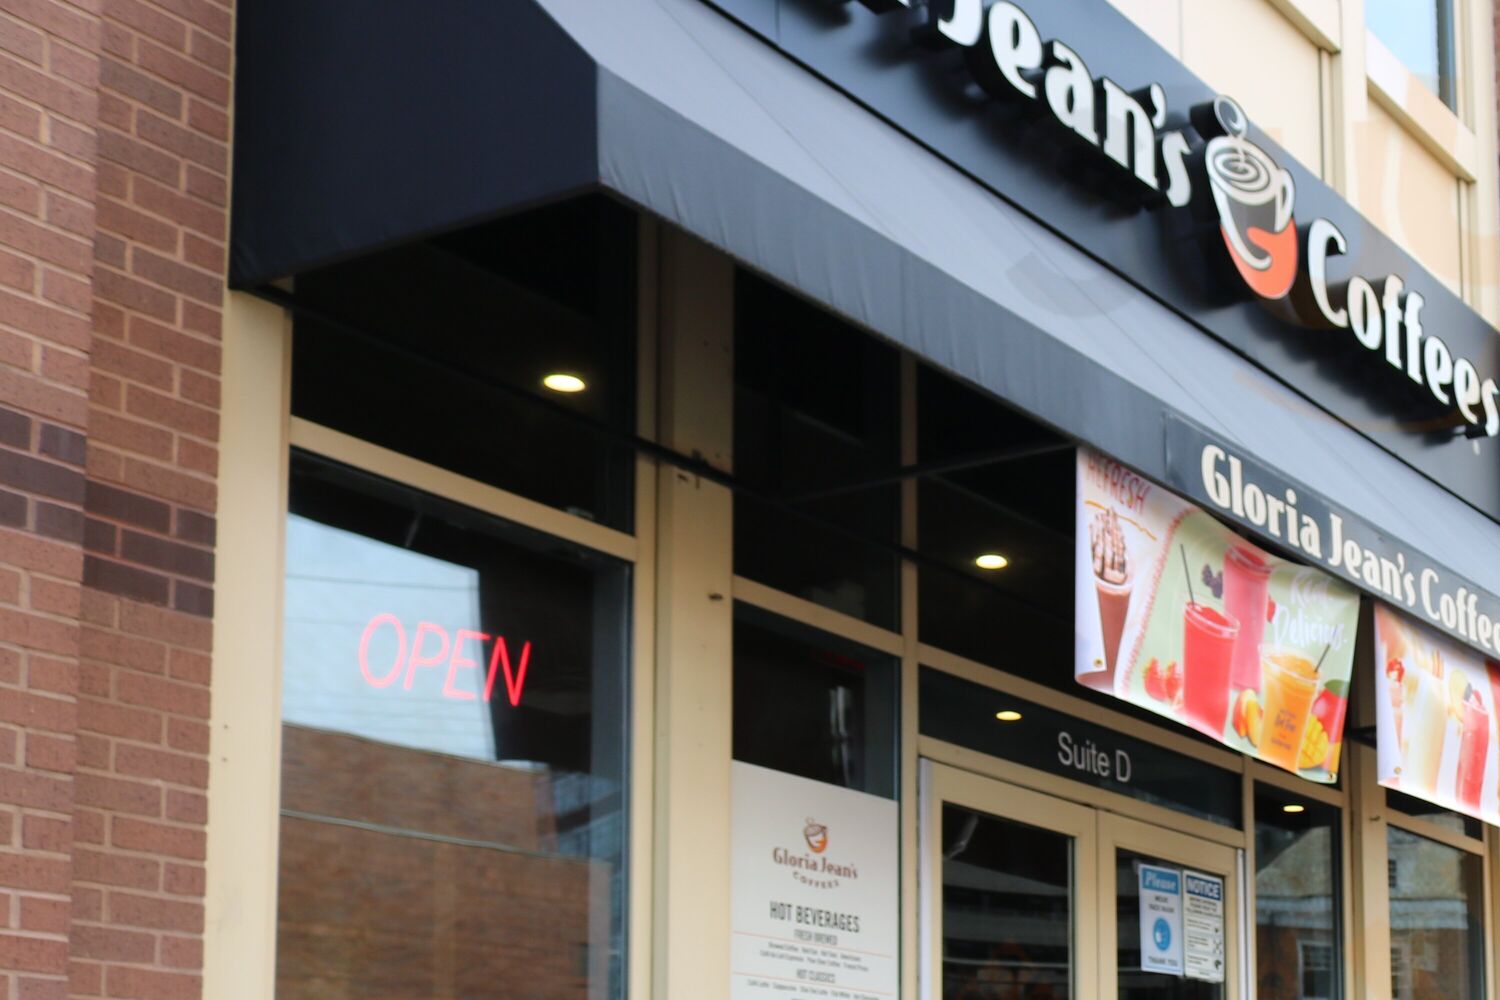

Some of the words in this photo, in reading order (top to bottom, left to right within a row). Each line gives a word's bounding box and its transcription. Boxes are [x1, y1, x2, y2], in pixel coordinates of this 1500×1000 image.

[1201, 444, 1322, 558] Gloria
[1328, 511, 1416, 608] Jean's
[358, 612, 532, 707] OPEN
[1058, 733, 1111, 774] Suite
[1115, 749, 1132, 783] D
[772, 847, 818, 872] Gloria
[1187, 878, 1221, 898] NOTICE
[770, 901, 793, 921] HOT
[796, 905, 860, 933] BEVERAGES
